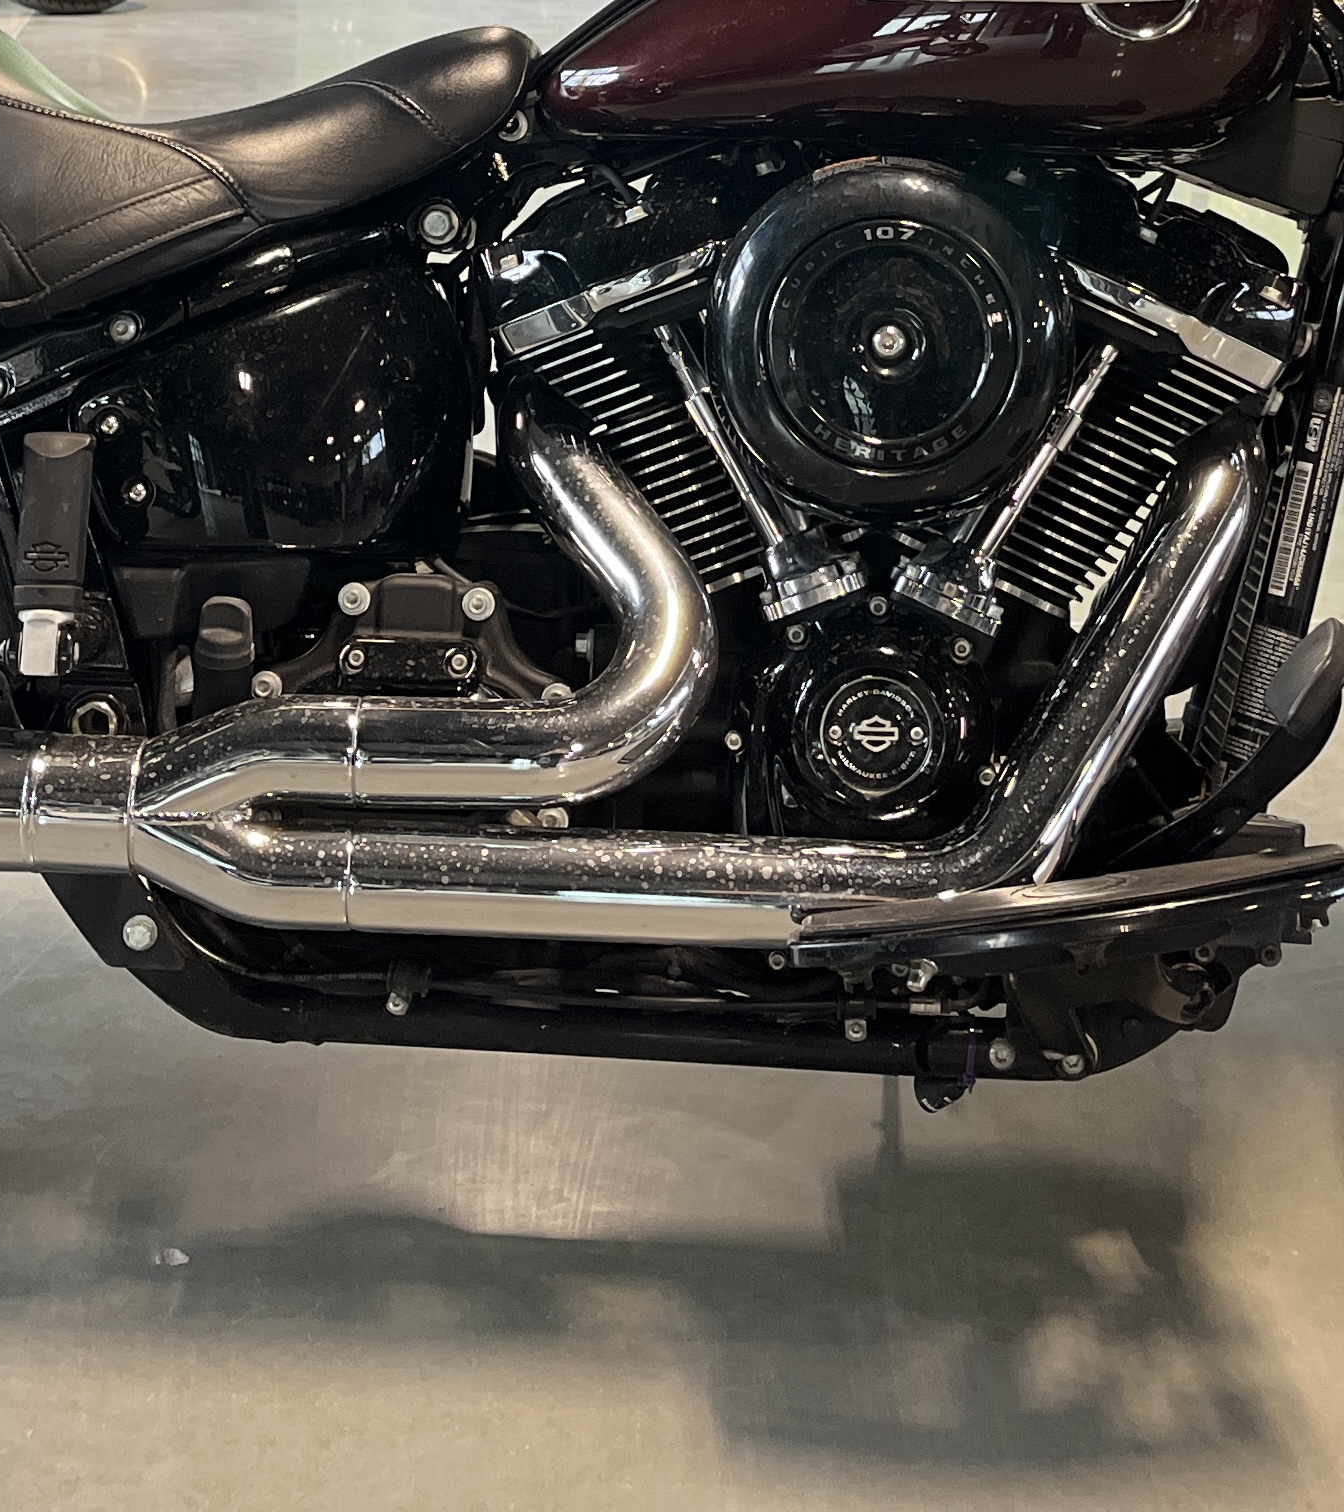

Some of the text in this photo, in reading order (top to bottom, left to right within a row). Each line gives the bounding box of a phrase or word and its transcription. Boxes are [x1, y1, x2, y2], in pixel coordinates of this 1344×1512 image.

[781, 225, 1004, 328] CUBIC 107 INCHES
[813, 423, 968, 462] HERITAGE
[837, 688, 915, 718] HARLEY-DAVIDSON
[837, 749, 916, 779] MILWAUKEE-EIGHT
